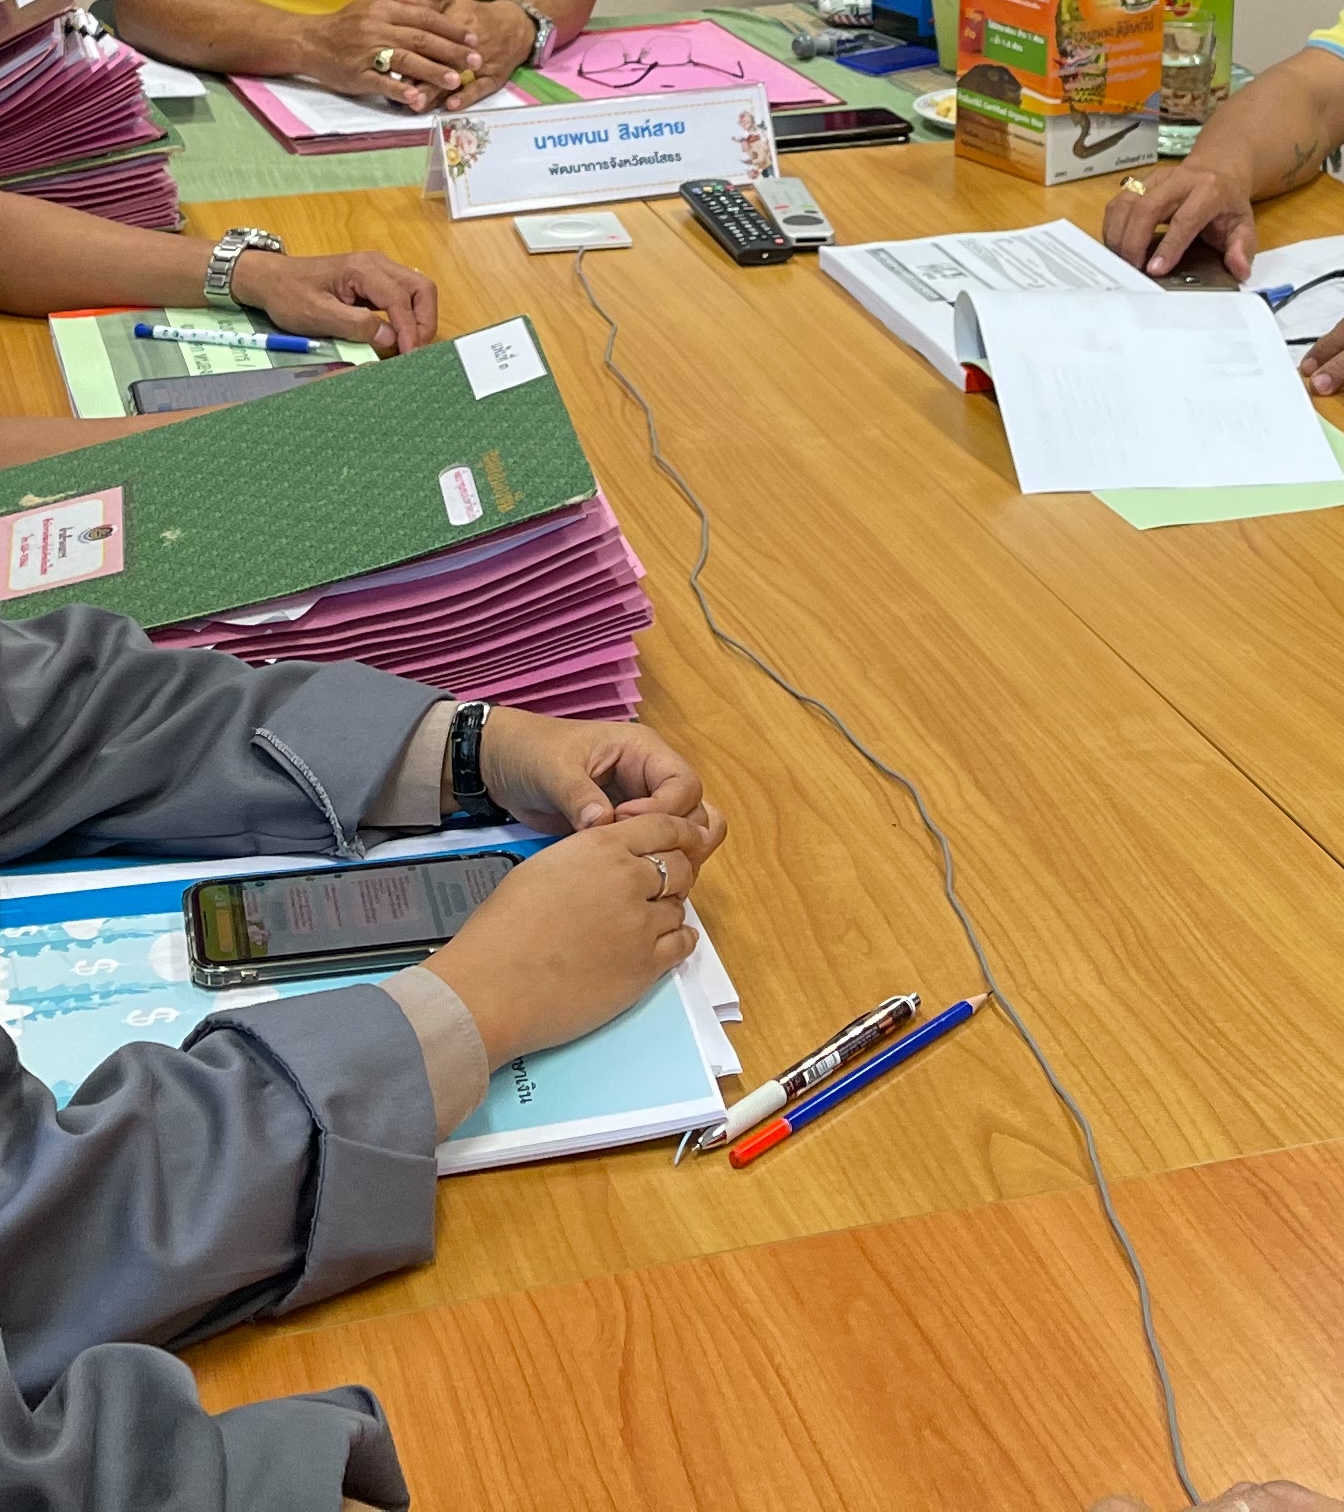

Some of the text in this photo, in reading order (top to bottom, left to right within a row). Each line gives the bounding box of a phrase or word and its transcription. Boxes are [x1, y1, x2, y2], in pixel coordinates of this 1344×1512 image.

[534, 119, 685, 150] นายพนม สิงห์สาย
[548, 152, 682, 176] พัฒนาการจังหวัดยโสธร
[512, 1056, 537, 1105] ษาเงิน
